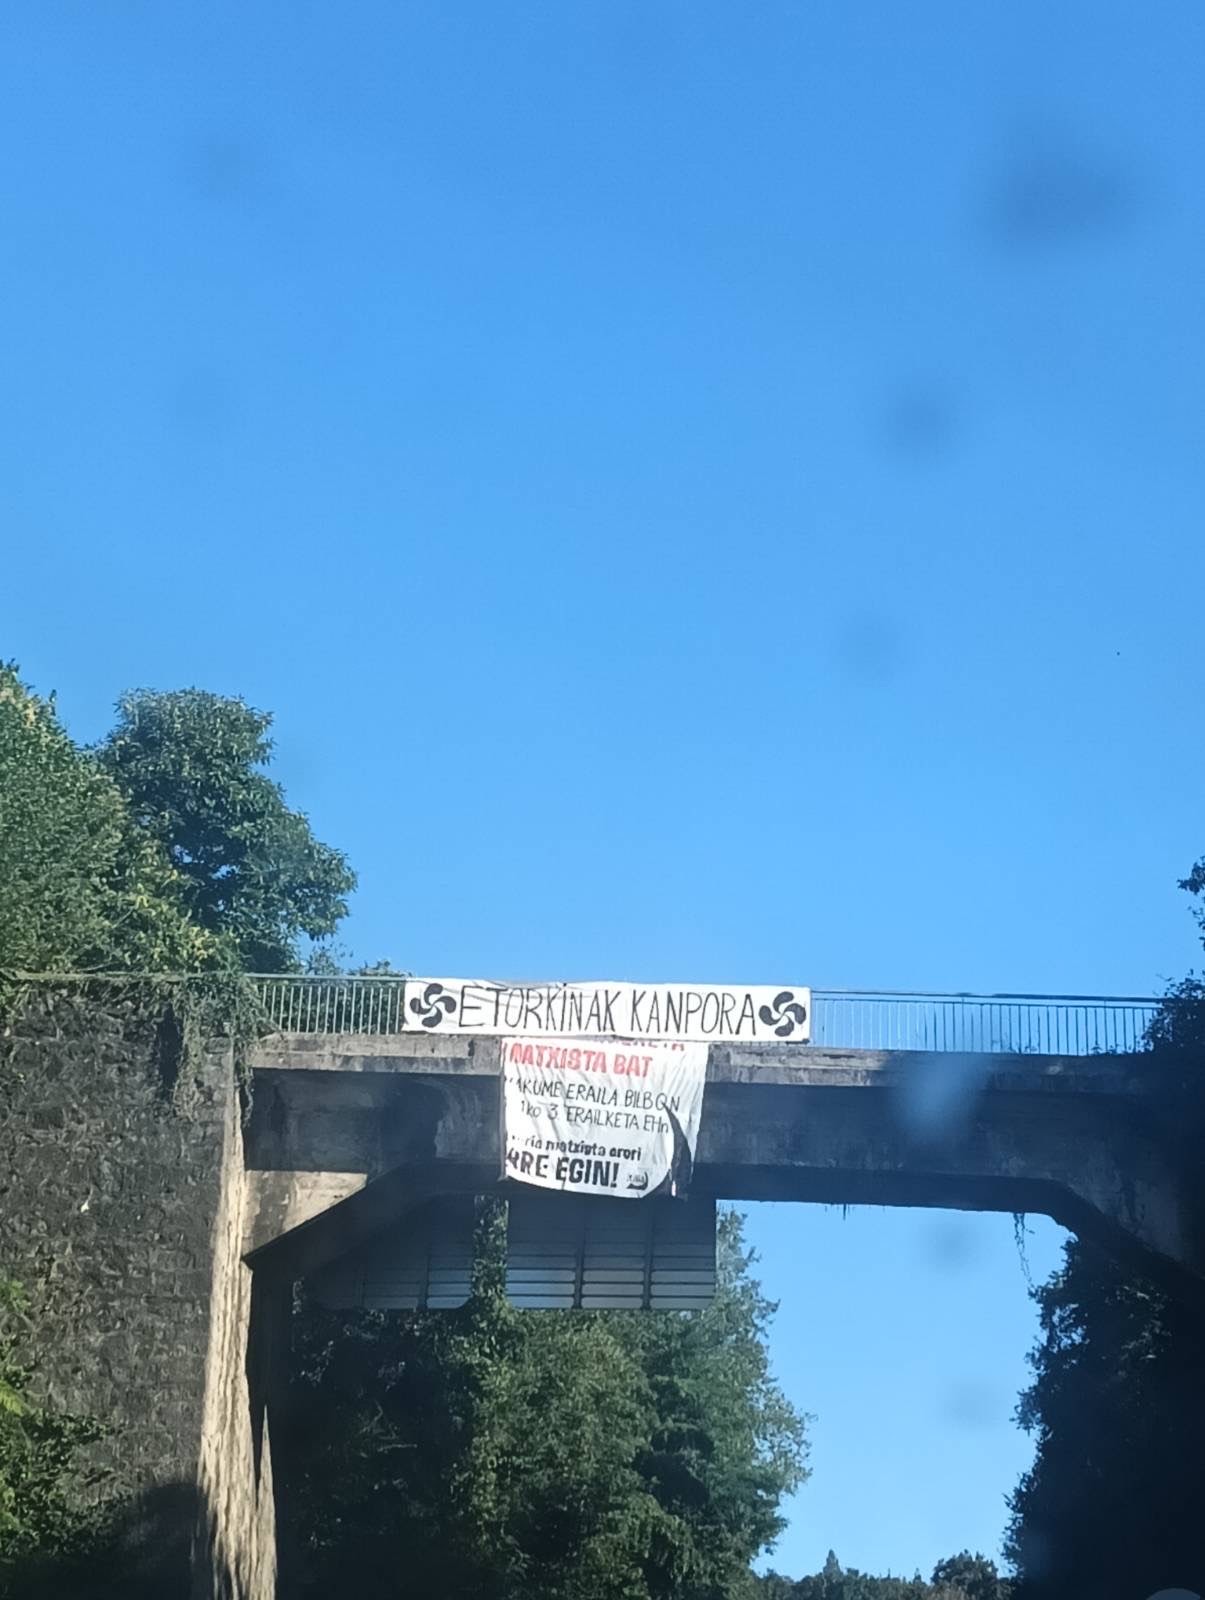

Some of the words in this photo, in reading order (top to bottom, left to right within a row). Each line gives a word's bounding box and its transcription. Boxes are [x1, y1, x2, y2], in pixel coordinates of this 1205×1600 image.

[630, 990, 756, 1036] KANPORA
[613, 1053, 653, 1078] BAT
[566, 1083, 618, 1107] ERAILA
[624, 1089, 681, 1113] BILBON
[566, 1106, 640, 1131] ERAILKETA
[556, 1156, 620, 1188] EGIN!
